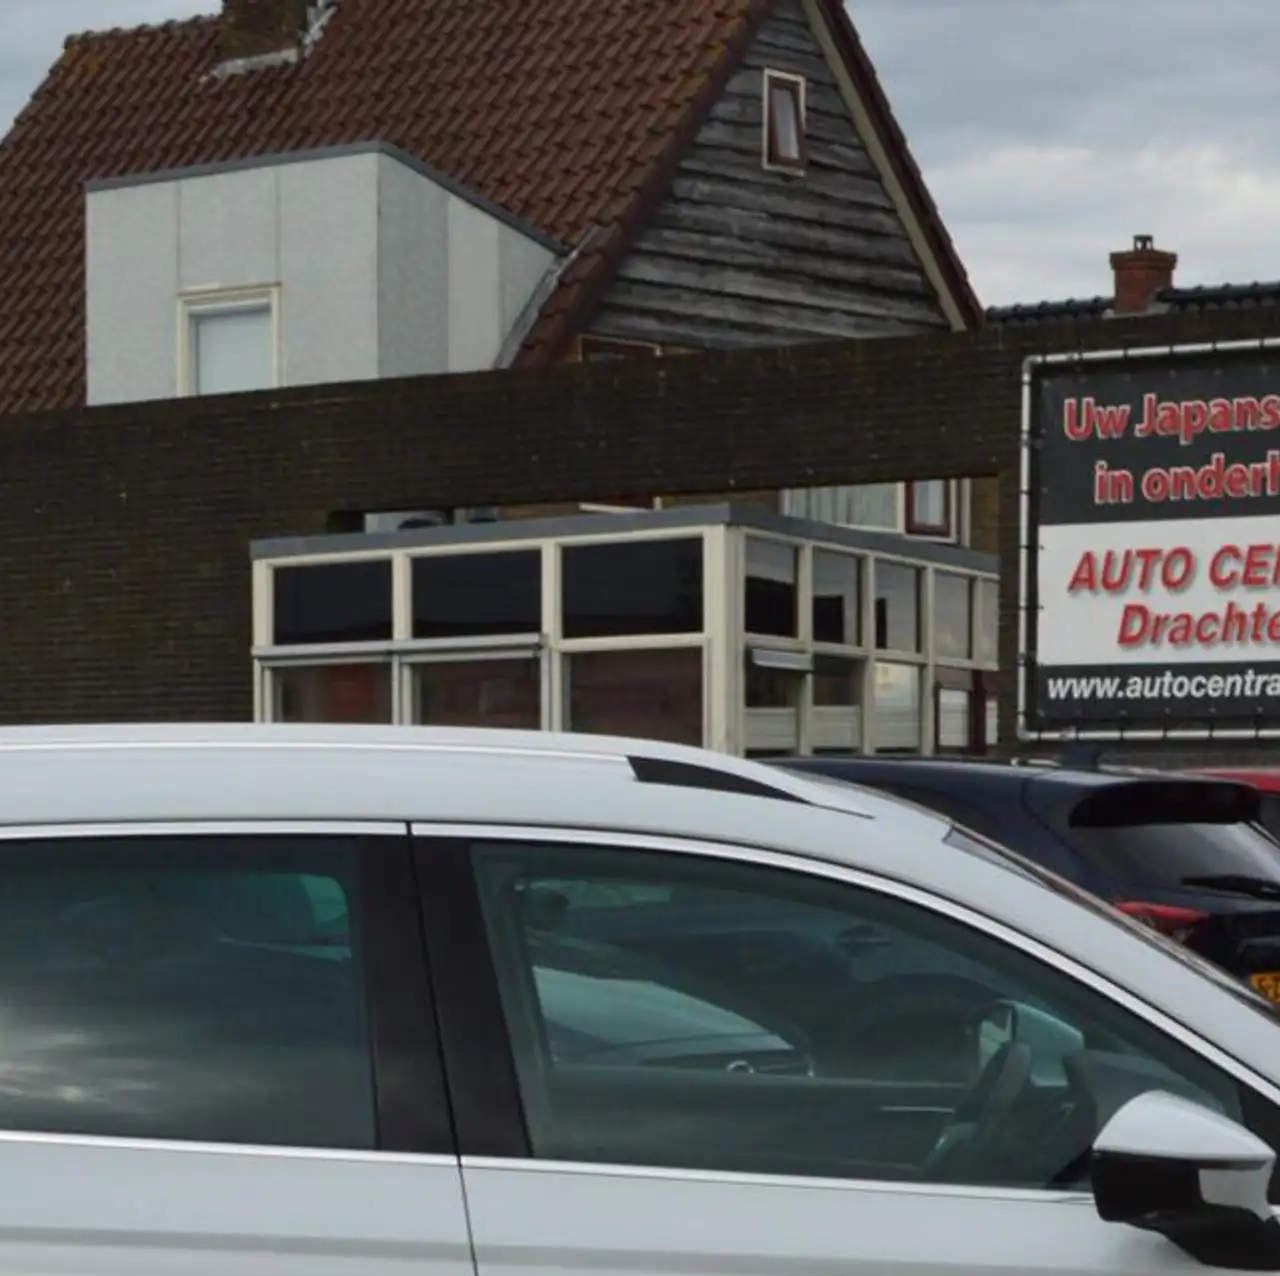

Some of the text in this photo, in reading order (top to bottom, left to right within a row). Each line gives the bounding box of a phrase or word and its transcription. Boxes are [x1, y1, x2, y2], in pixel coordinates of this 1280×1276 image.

[1063, 396, 1131, 441] Uw
[1094, 460, 1134, 505] in
[1068, 546, 1193, 594] AUTO
